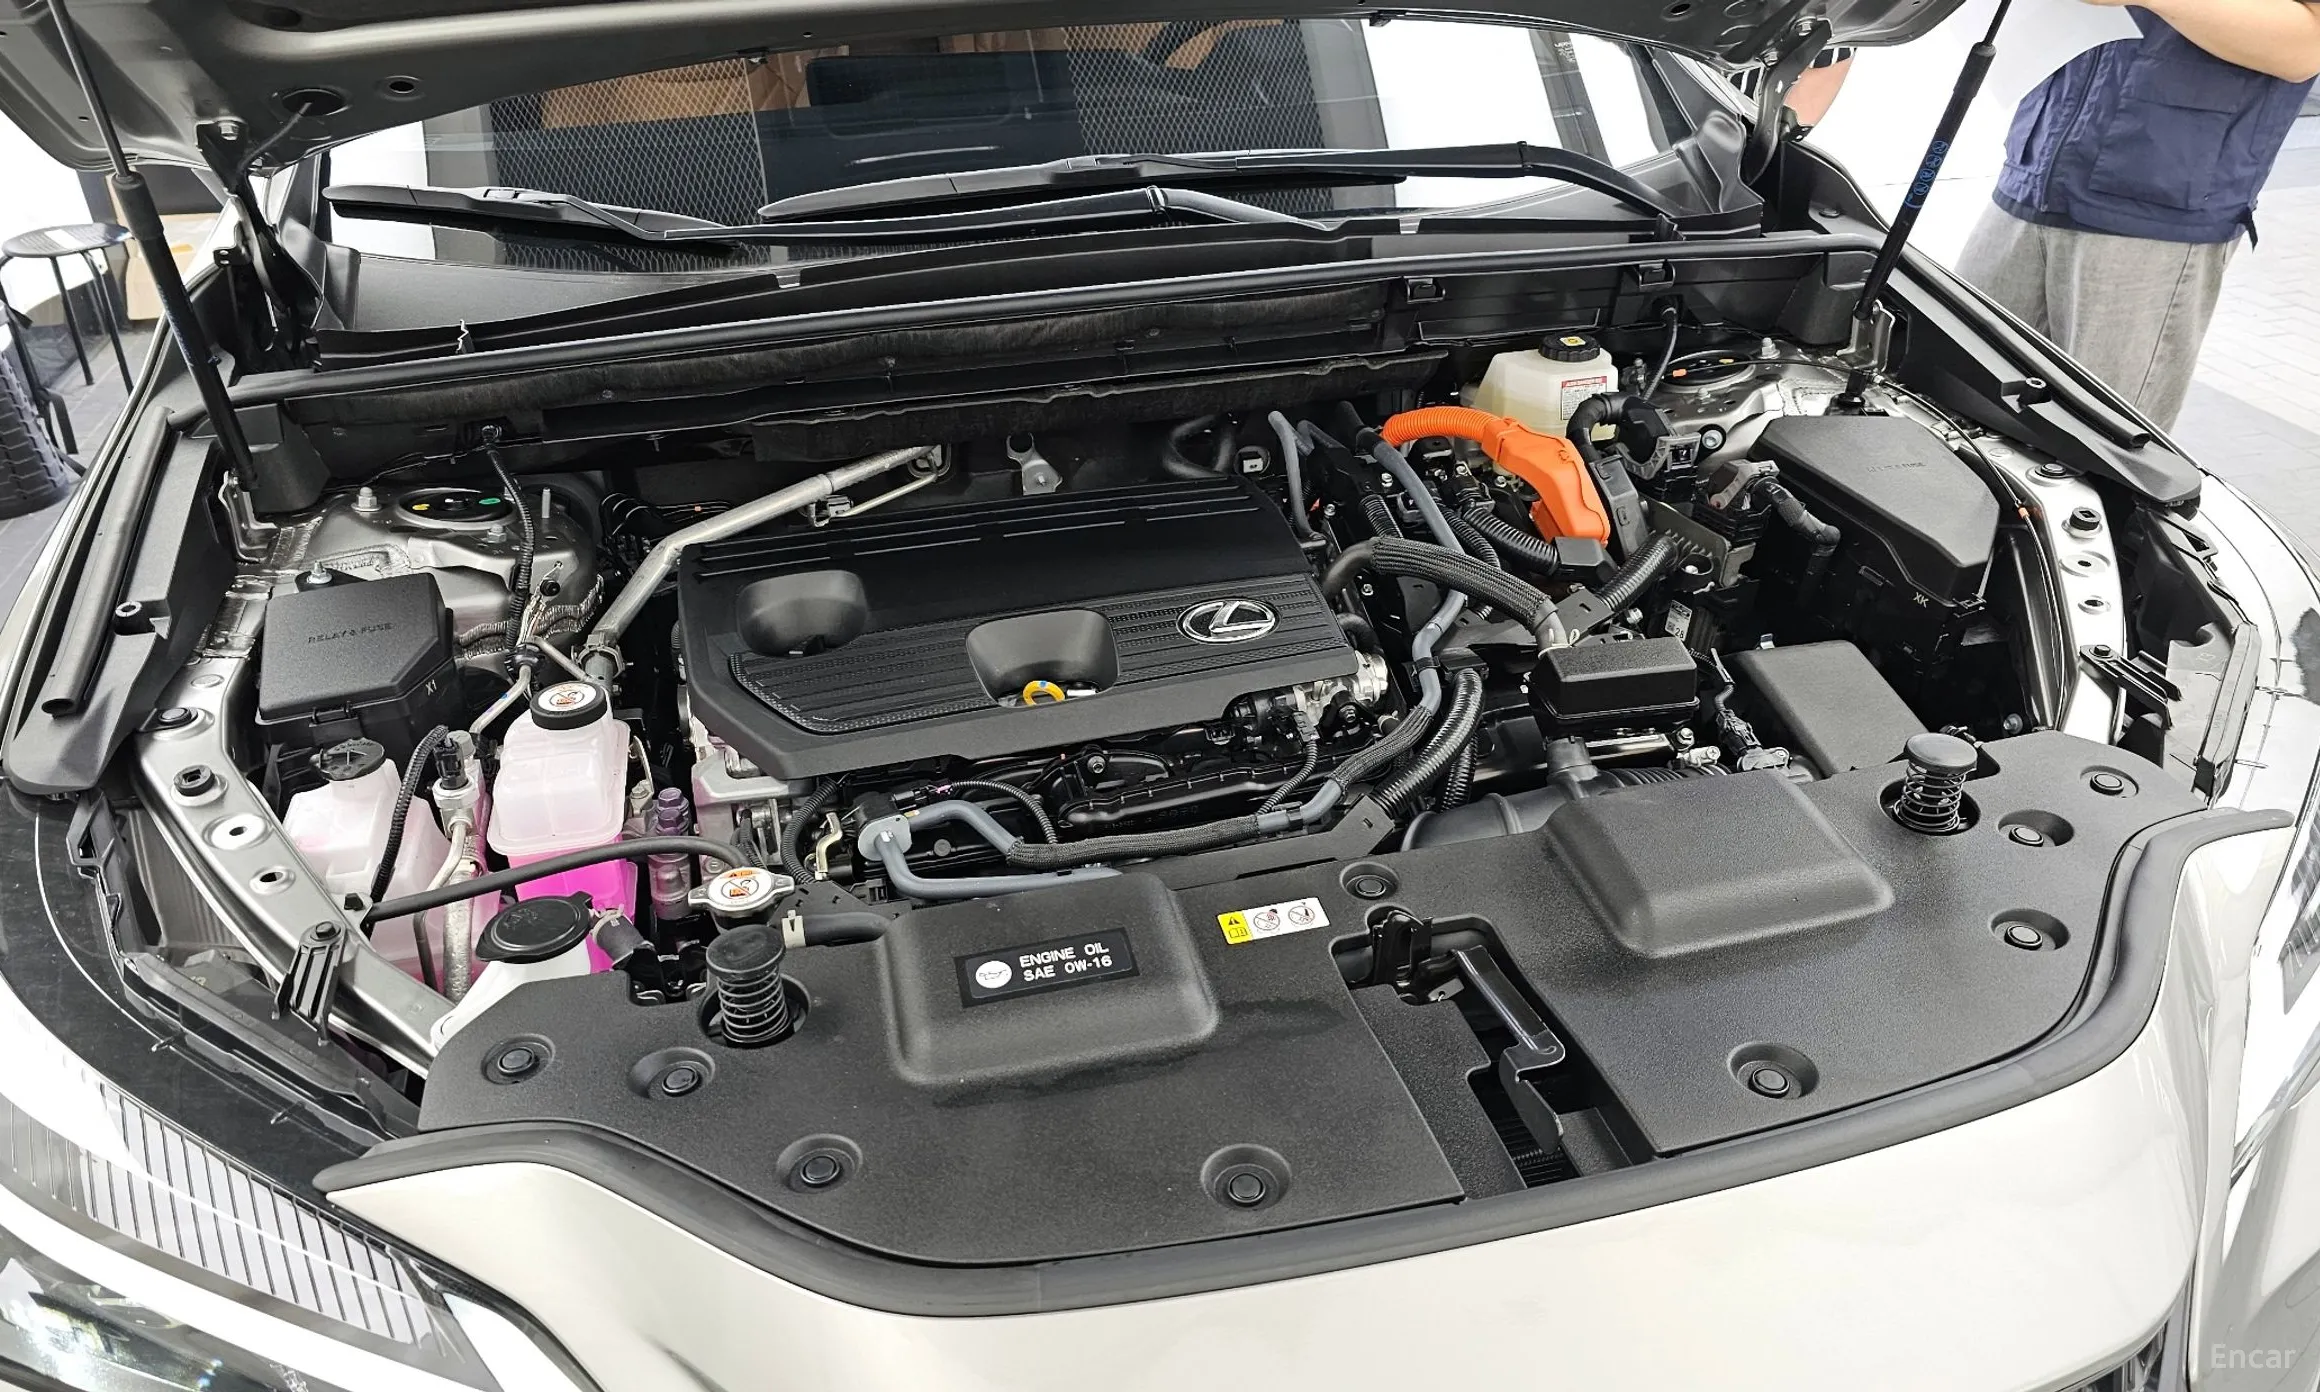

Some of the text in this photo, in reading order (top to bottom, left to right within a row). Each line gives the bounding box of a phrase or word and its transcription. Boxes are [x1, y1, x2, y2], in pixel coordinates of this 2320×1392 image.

[1913, 592, 1929, 608] XK
[425, 679, 437, 696] X1
[1019, 942, 1110, 968] ENGINE OIL
[1023, 955, 1113, 982] SAE 0W-16
